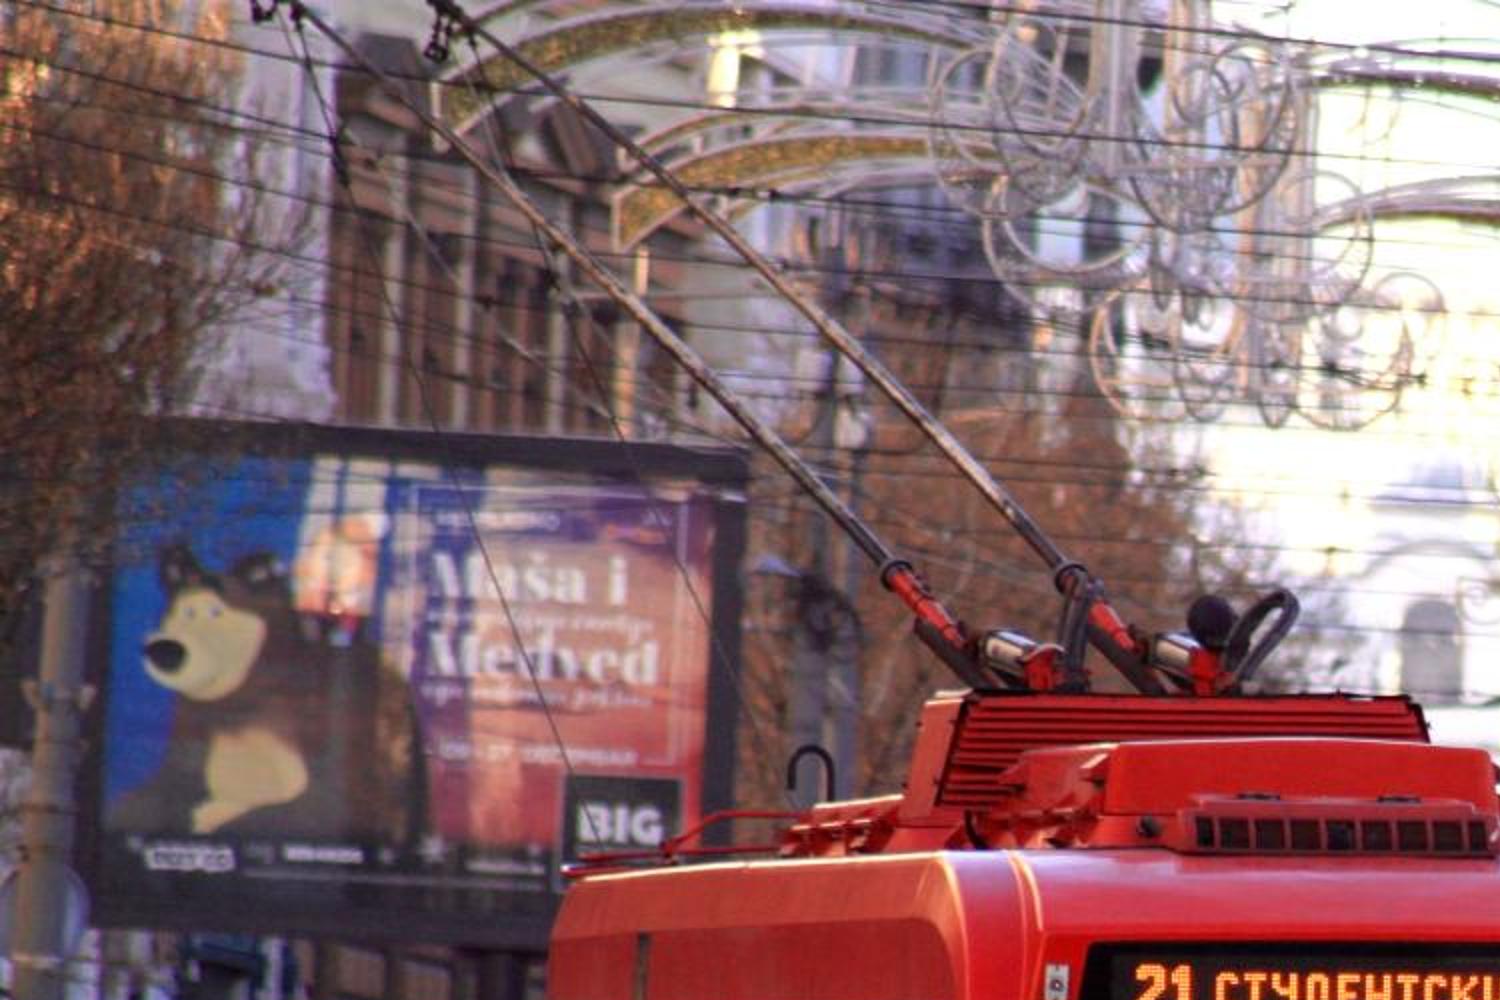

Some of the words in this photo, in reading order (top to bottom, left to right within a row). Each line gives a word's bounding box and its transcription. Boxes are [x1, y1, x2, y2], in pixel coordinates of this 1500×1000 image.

[431, 551, 589, 603] Maša
[608, 555, 629, 605] i
[429, 626, 661, 687] Medved
[578, 802, 665, 846] BIG
